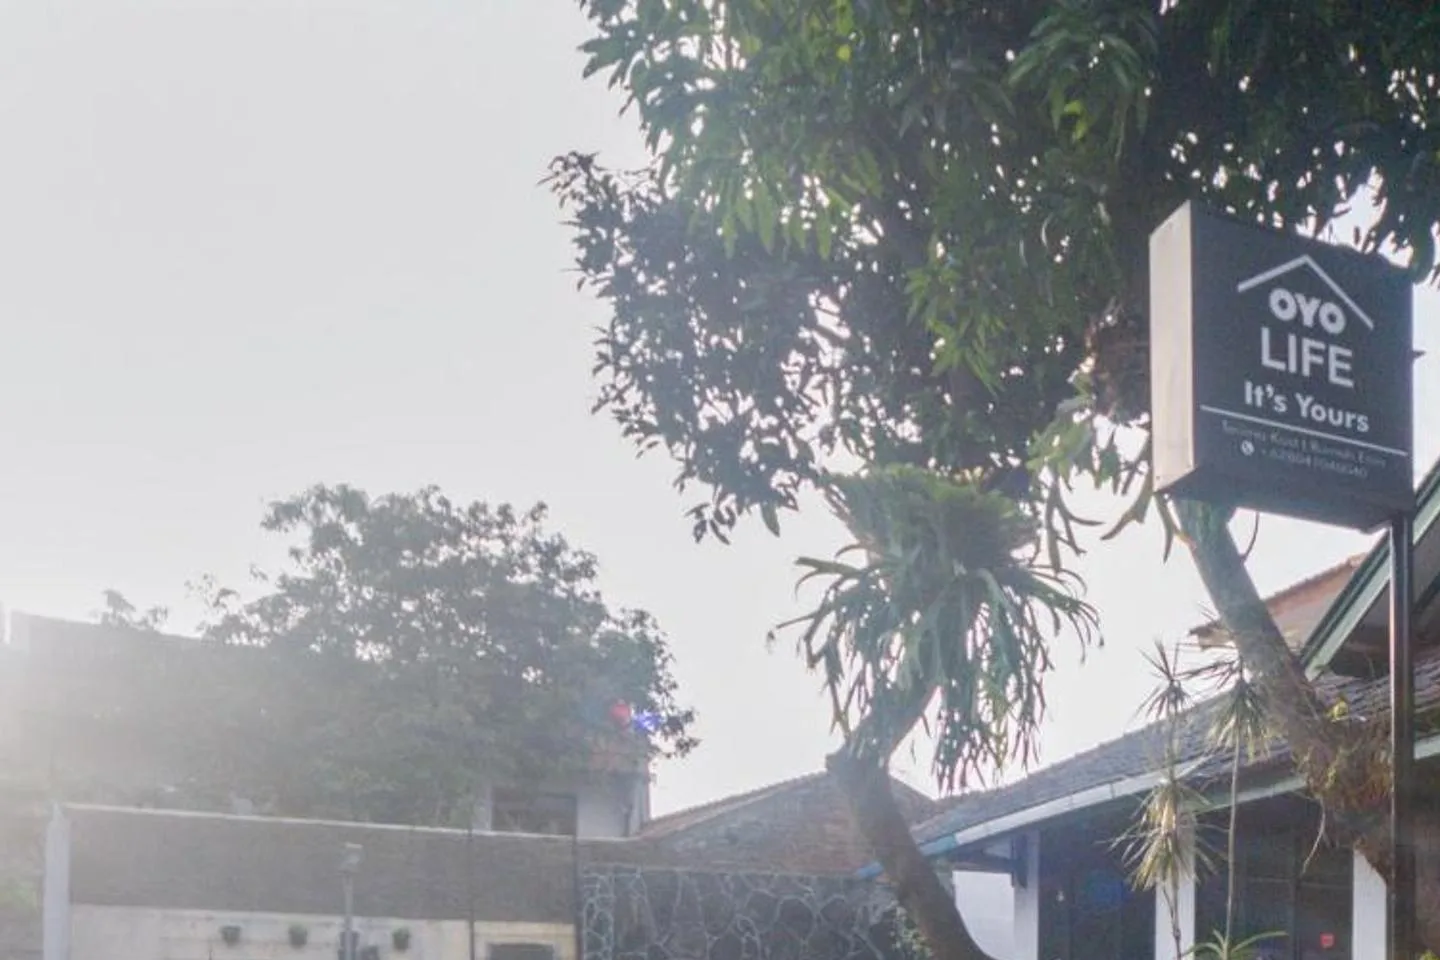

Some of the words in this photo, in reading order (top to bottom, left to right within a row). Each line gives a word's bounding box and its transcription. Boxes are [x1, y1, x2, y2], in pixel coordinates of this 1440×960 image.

[1269, 288, 1346, 334] OYO
[1261, 326, 1354, 388] LIFE
[1244, 380, 1287, 413] It's
[1295, 392, 1369, 432] Yours
